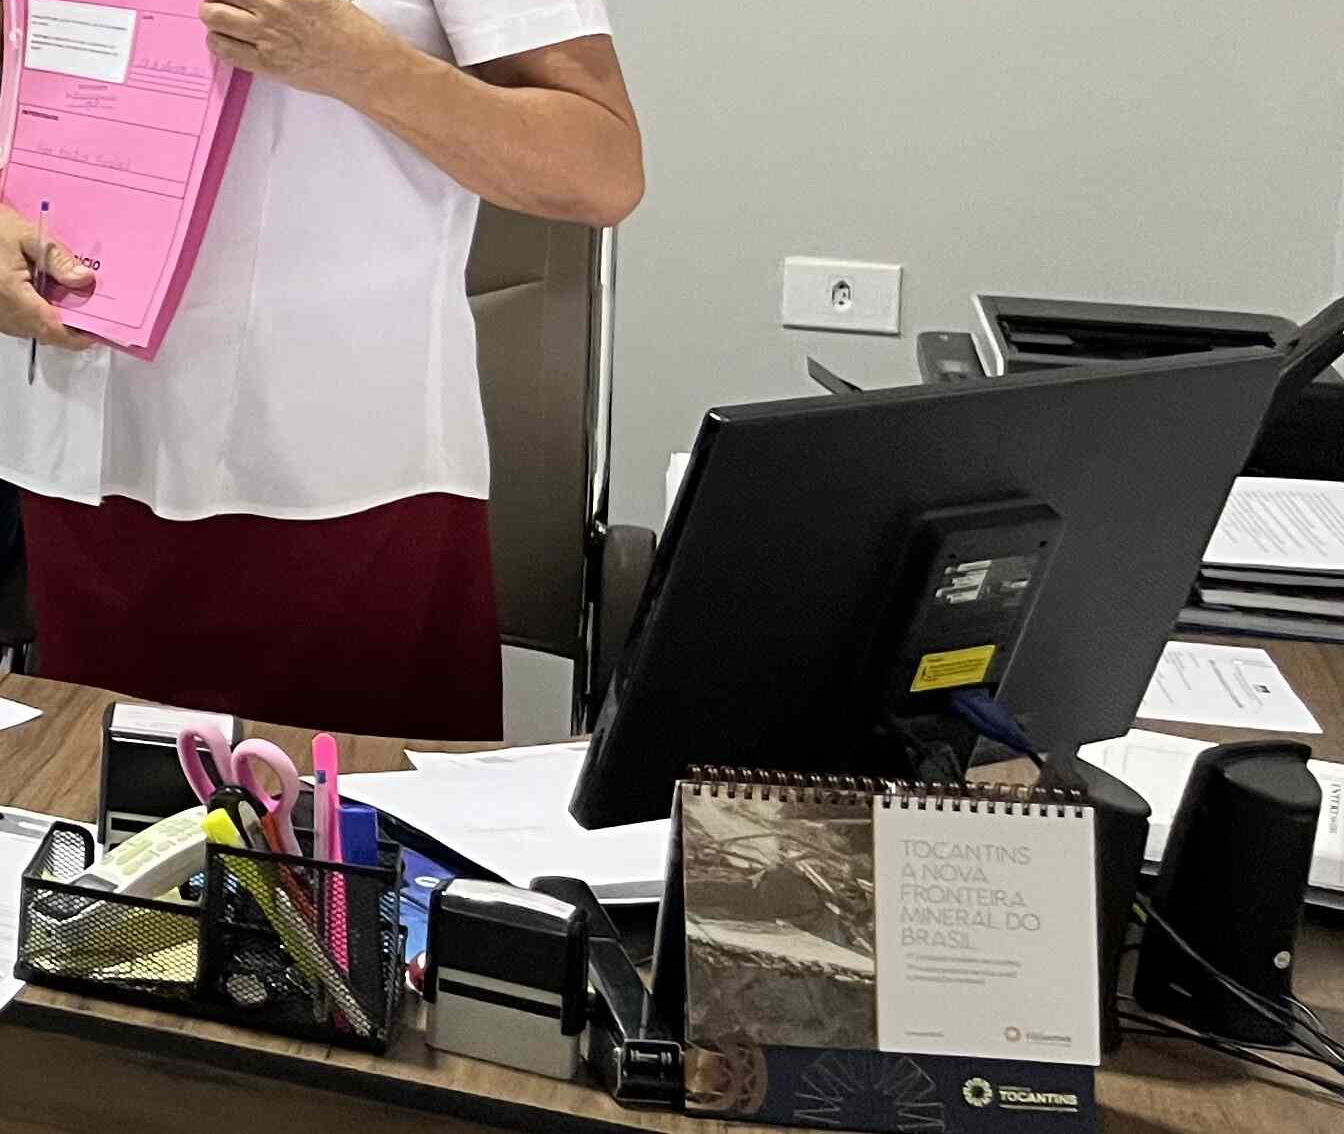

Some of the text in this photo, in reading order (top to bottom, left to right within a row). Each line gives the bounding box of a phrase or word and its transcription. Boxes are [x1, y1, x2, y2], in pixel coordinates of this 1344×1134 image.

[900, 839, 1033, 866] TOCANTINS
[921, 863, 990, 884] NOVA
[899, 883, 1029, 908] FRONTEIRA
[901, 905, 1041, 932] MINERAL DO
[901, 927, 978, 951] BRASIL
[998, 1090, 1079, 1106] TOCANTINS
